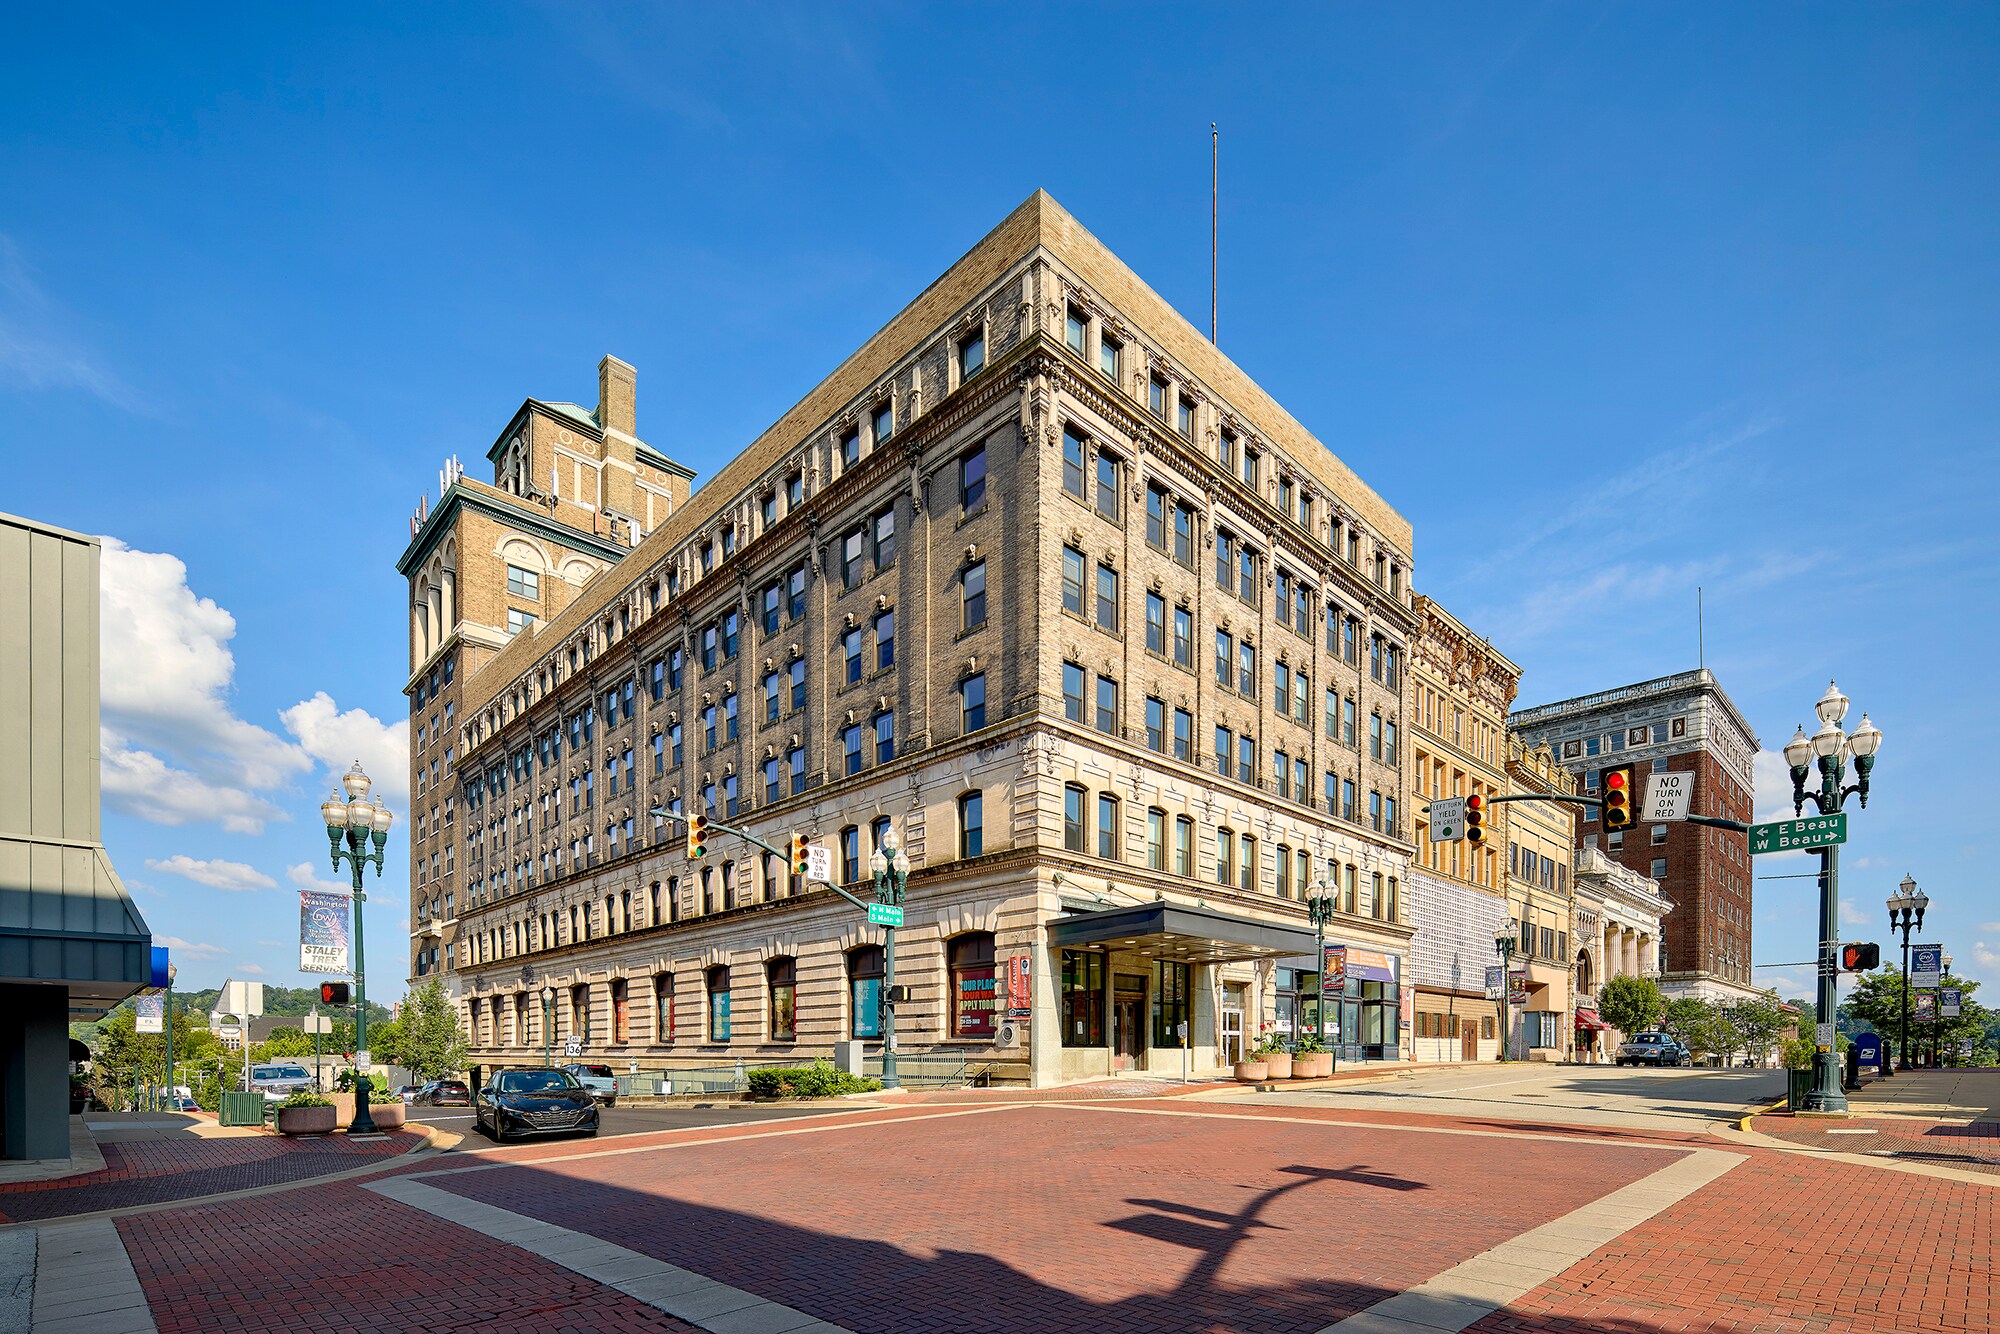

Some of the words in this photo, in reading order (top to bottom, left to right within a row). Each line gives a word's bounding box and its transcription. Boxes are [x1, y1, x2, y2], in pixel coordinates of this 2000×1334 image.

[1660, 776, 1680, 788] NO
[1655, 789, 1682, 798] TURN
[1446, 801, 1462, 809] TURN
[1658, 799, 1674, 807] ON
[1439, 809, 1457, 818] YIELD
[1655, 808, 1675, 818] RED
[1443, 818, 1462, 826] GREEN
[1779, 824, 1789, 835] E
[1795, 818, 1838, 833] Beau
[1756, 839, 1769, 850] W
[1780, 834, 1821, 847] Beau
[813, 849, 825, 858] NO
[812, 857, 827, 865] TURN
[813, 871, 825, 879] RED
[302, 898, 348, 908] Washington
[886, 907, 901, 916] Main
[878, 914, 894, 923] Main
[304, 945, 344, 956] STALEY
[311, 955, 338, 965] TREE
[302, 963, 347, 973] SERVICE
[960, 979, 977, 991] YOUR
[961, 991, 980, 1000] YOUR
[960, 1000, 978, 1011] APPLY
[567, 1046, 580, 1054] 136
